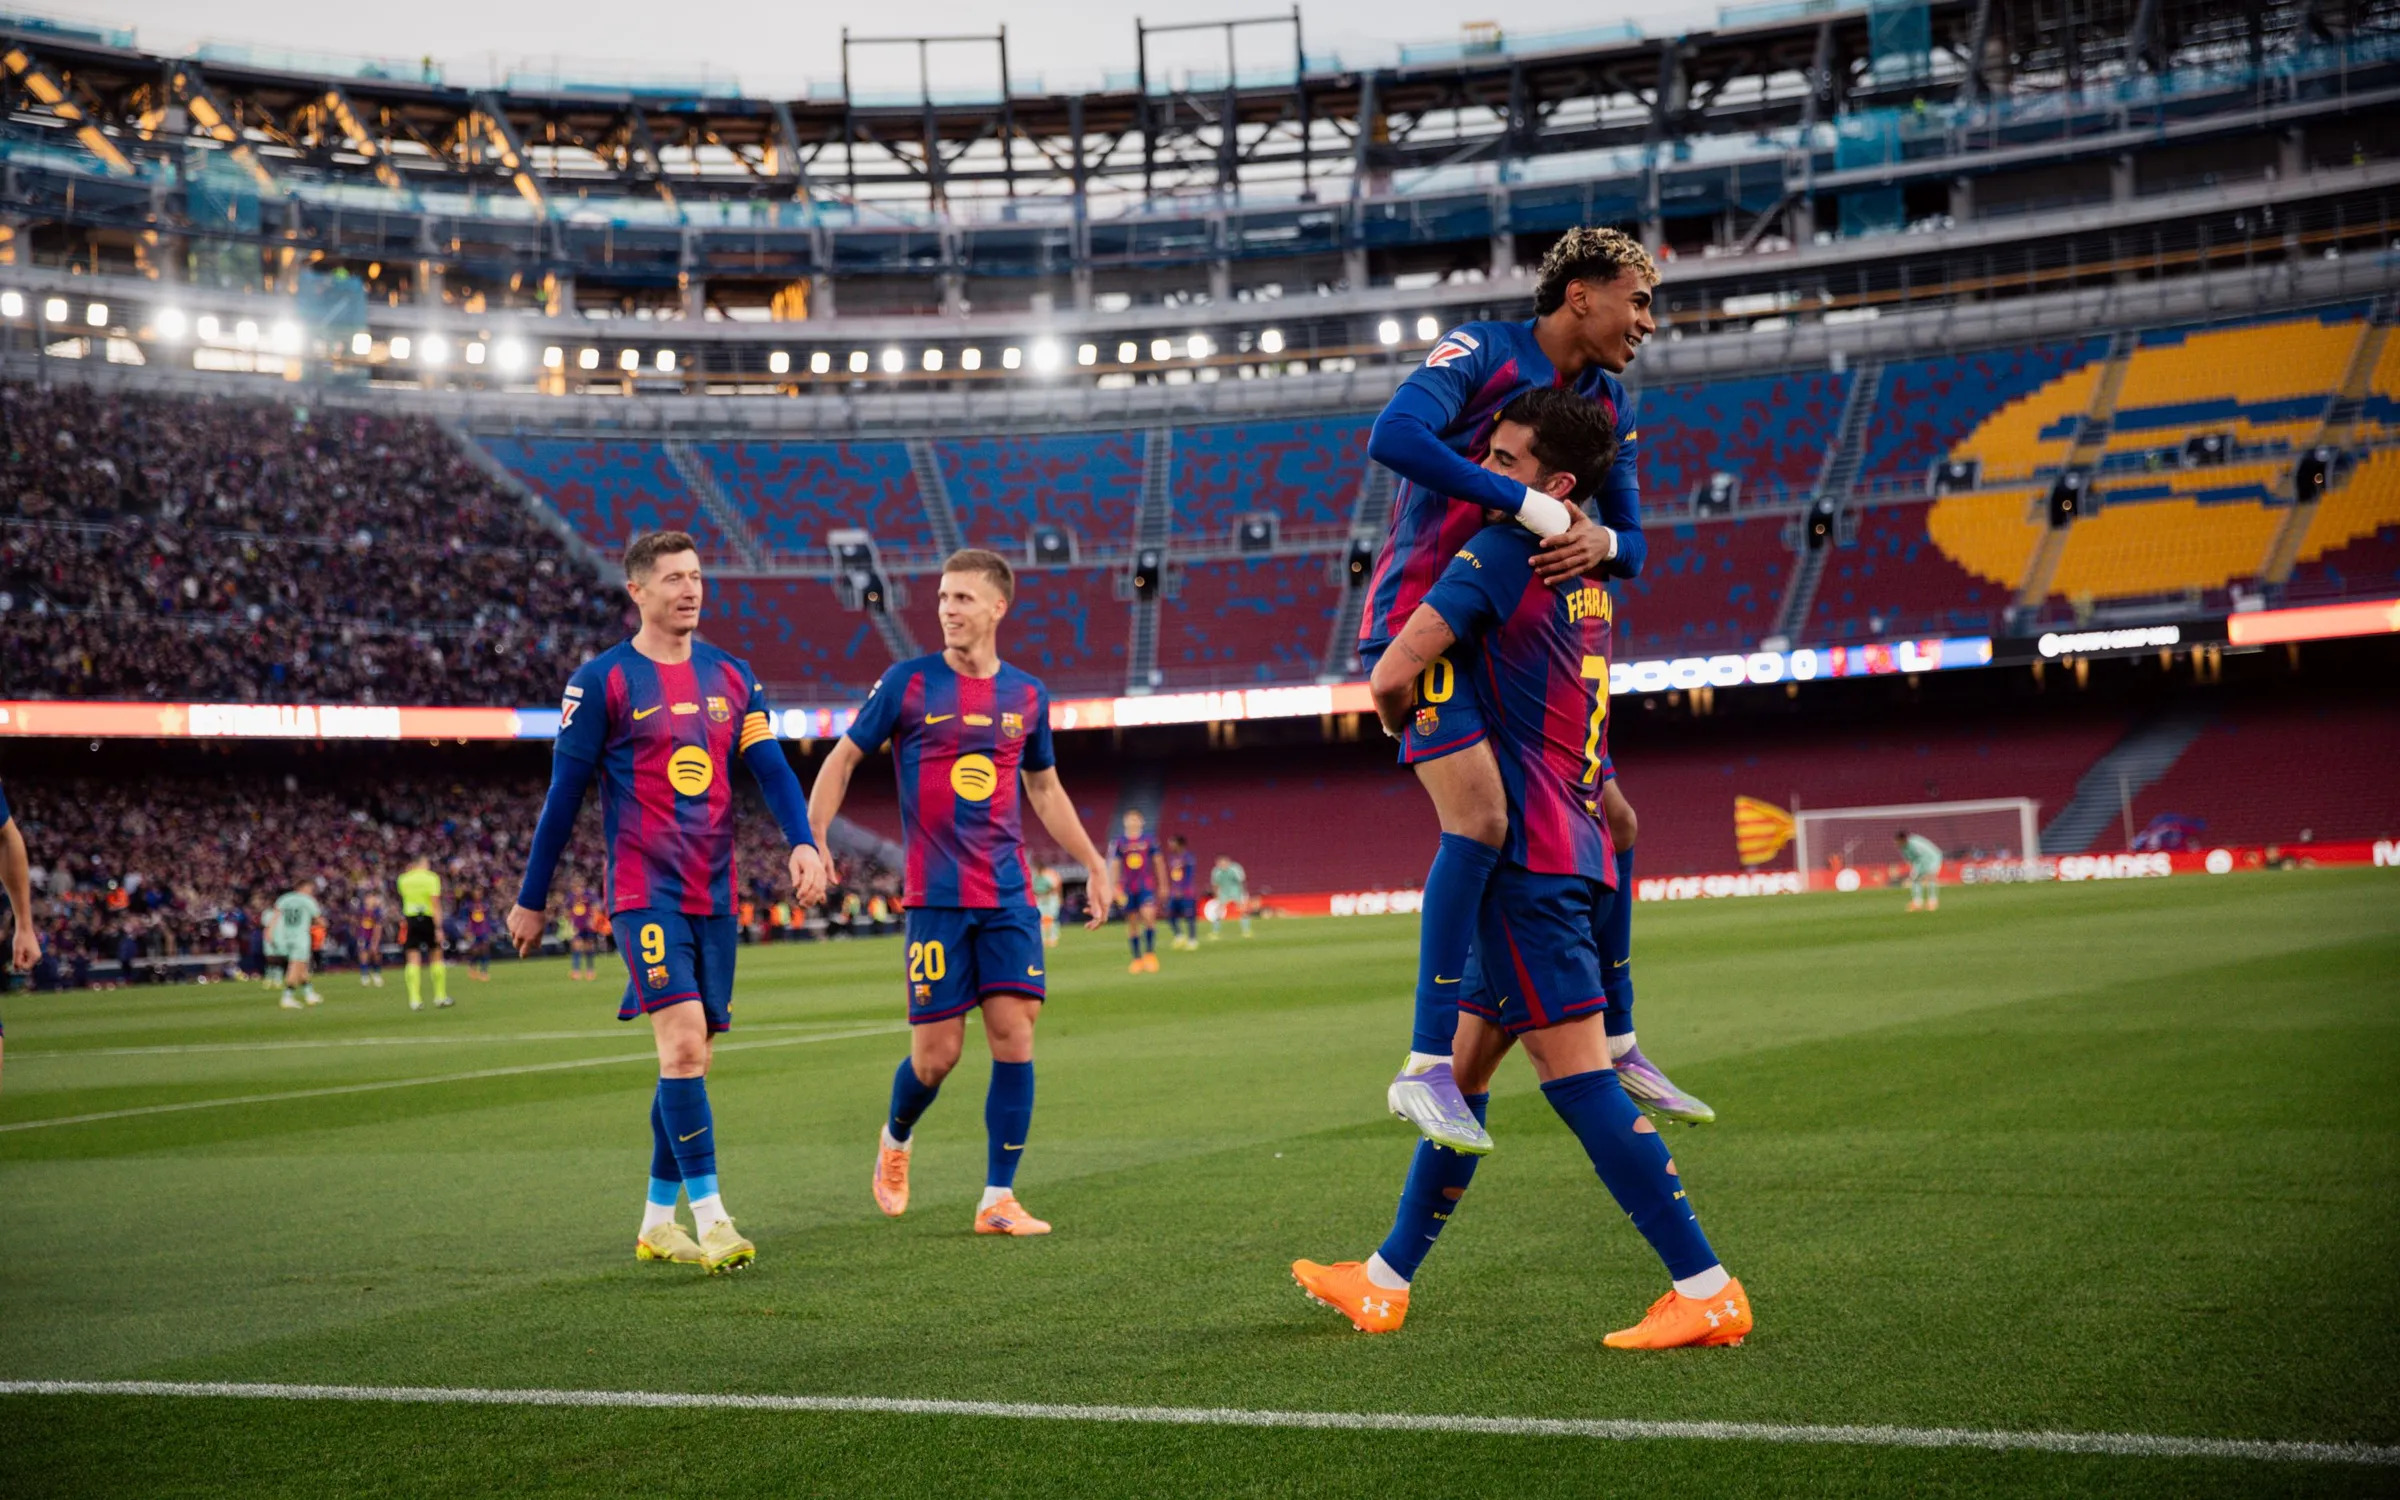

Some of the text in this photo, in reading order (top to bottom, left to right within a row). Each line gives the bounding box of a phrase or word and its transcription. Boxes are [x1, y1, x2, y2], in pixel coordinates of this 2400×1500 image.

[1580, 655, 1609, 784] 7
[2058, 852, 2171, 882] SPADES
[640, 923, 665, 964] 9
[909, 940, 946, 982] 20
